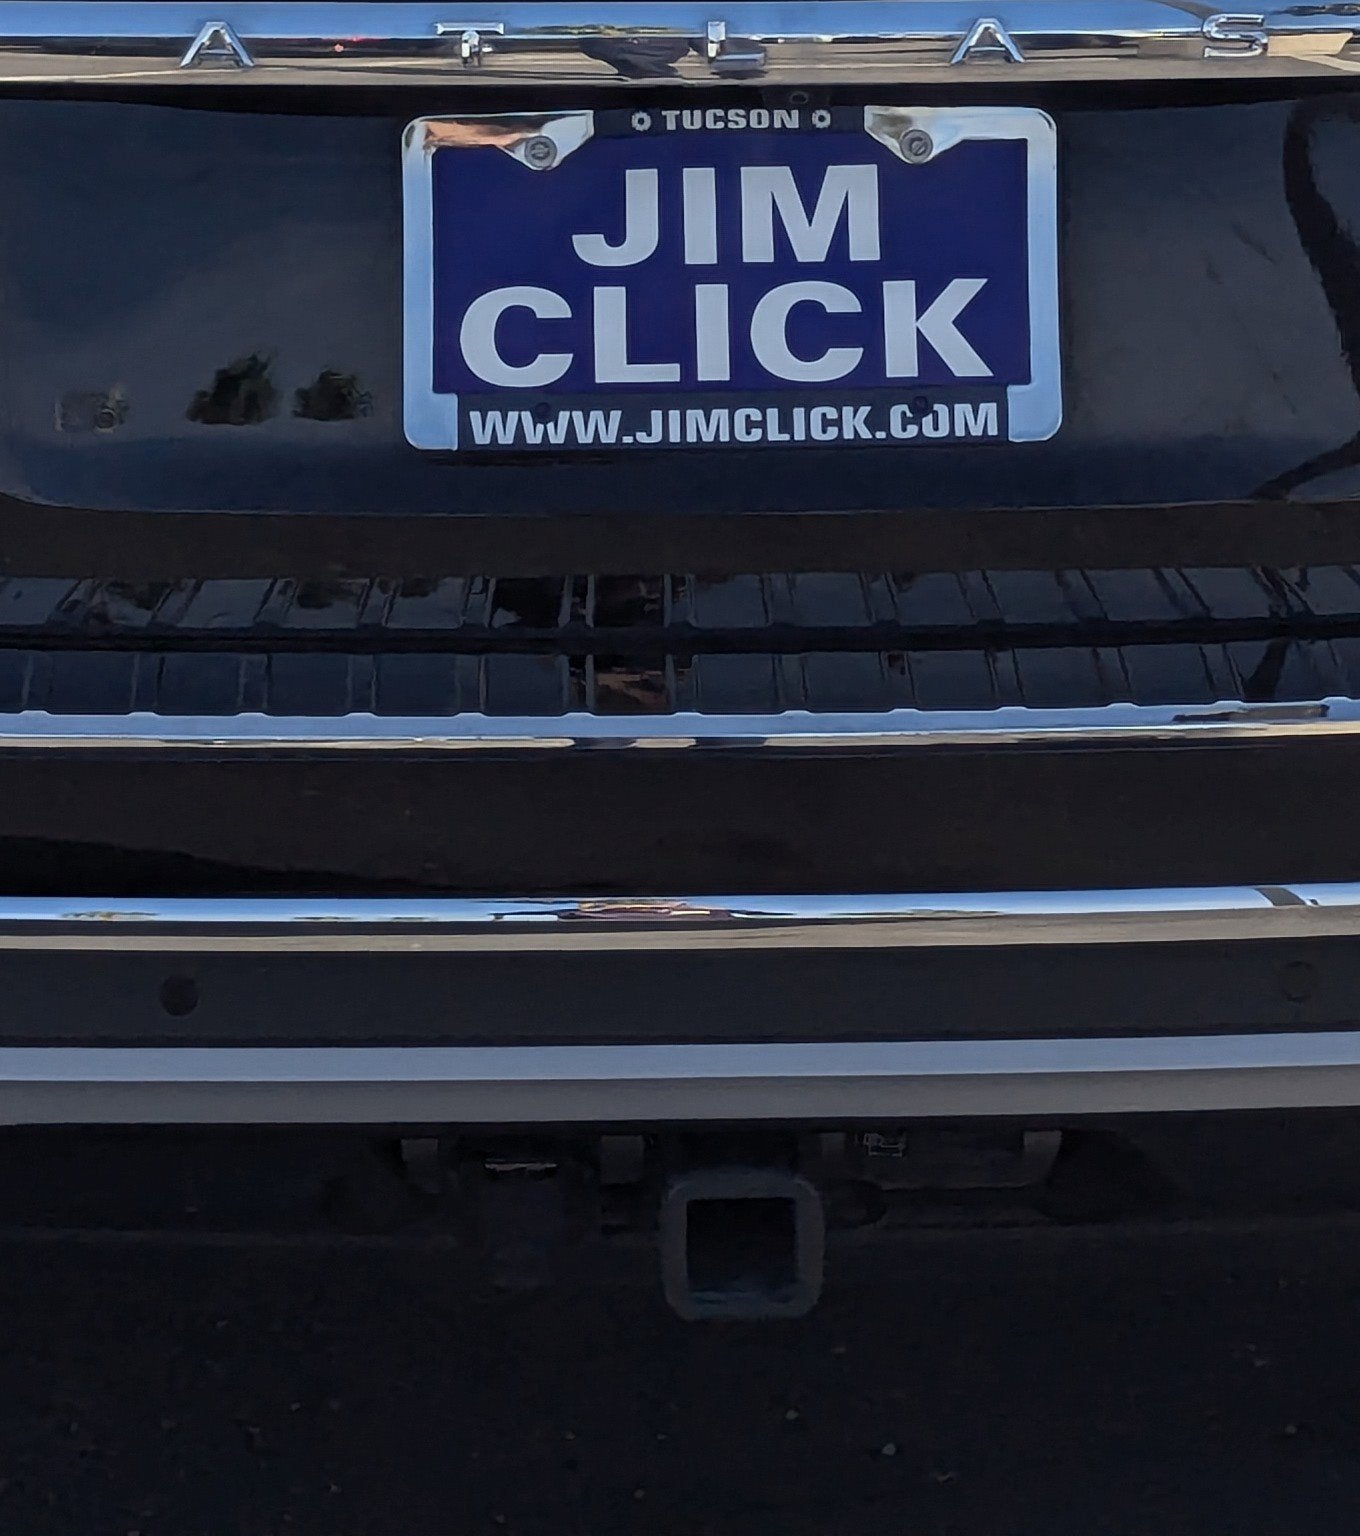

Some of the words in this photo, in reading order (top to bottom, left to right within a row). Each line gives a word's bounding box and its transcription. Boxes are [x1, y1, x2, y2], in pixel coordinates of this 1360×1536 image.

[179, 10, 1270, 71] ATLAS
[662, 107, 800, 131] TUCSON
[571, 163, 882, 267] JIM
[458, 277, 995, 388] CLICK
[468, 401, 999, 446] WWW.JIMCLICK.COM
